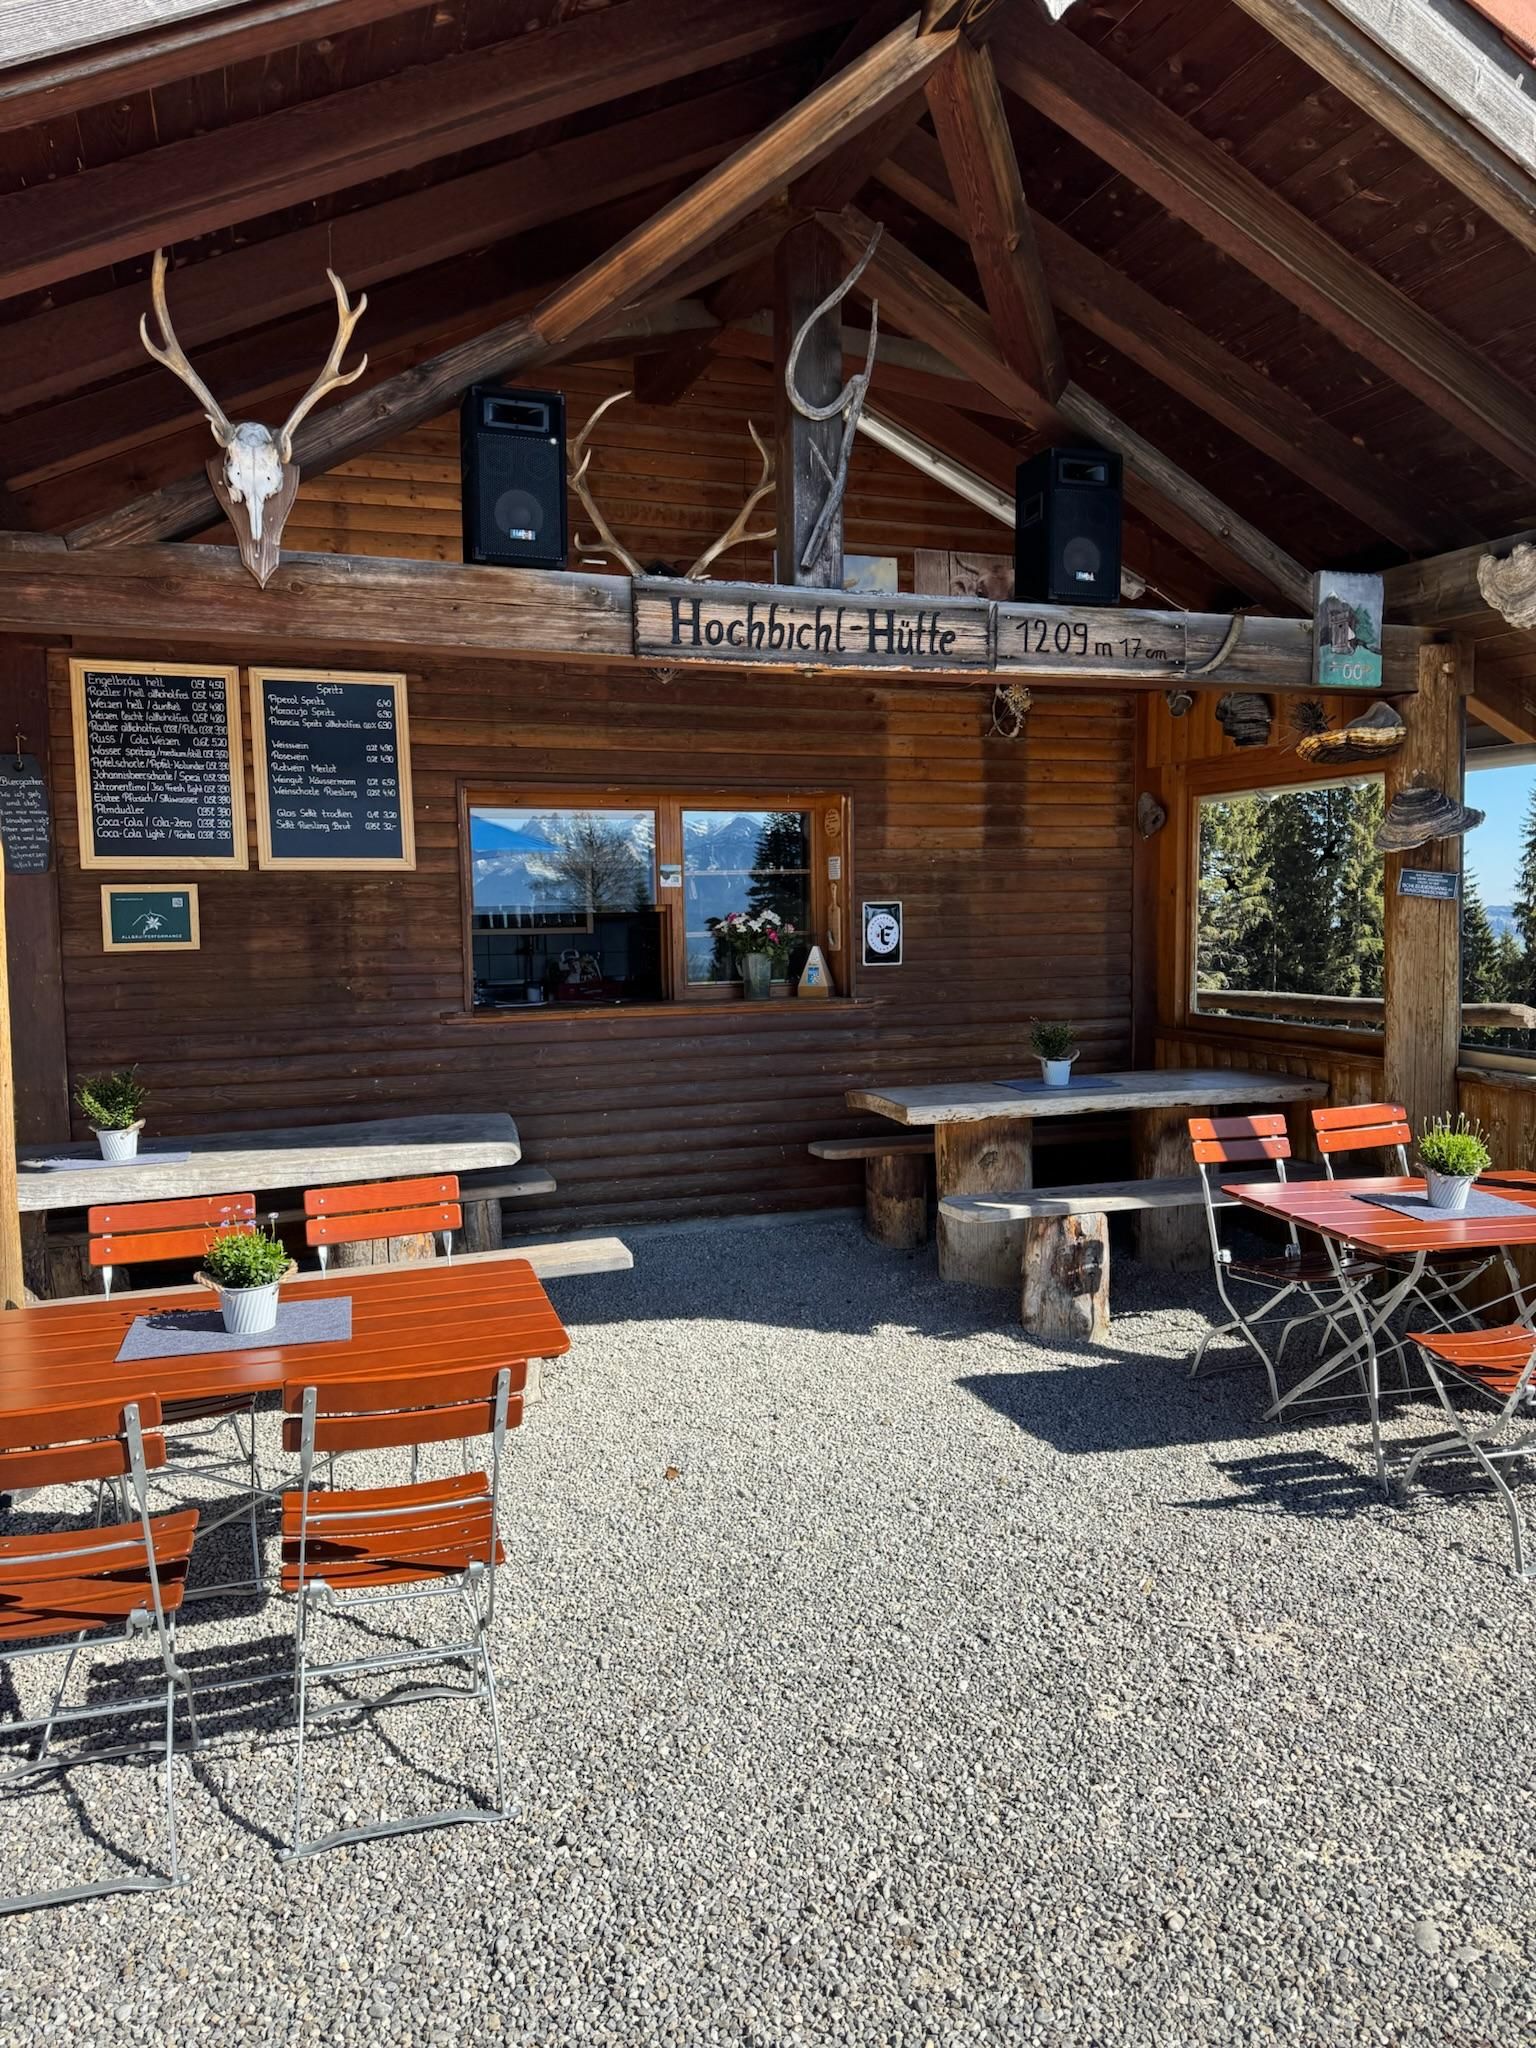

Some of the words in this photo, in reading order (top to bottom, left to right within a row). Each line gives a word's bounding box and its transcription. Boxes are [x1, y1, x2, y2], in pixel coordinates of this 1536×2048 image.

[669, 597, 957, 656] Hochbichl-Hütte
[1016, 619, 1088, 655] 1209
[1095, 642, 1112, 658] m
[1119, 638, 1142, 658] 17
[1145, 648, 1168, 660] cm
[145, 677, 165, 687] hell
[87, 686, 120, 697] Radler
[129, 688, 145, 698] hell
[148, 689, 190, 700] alkoholfrei
[316, 684, 344, 696] Spritz
[89, 698, 122, 709] Weizen
[126, 699, 144, 710] hell
[152, 701, 181, 711] dunkel
[268, 694, 299, 705] Aperol
[301, 696, 326, 706] Spritz
[89, 710, 118, 720] Weizen
[121, 711, 143, 721] leicht
[270, 705, 308, 717] Maracuja
[311, 707, 336, 718] Spritz
[89, 720, 118, 731] Radler
[121, 722, 162, 733] alkoholfrei
[269, 716, 300, 727] Arancia
[302, 718, 323, 728] Spritz
[325, 719, 361, 729] alkoholfrei
[89, 732, 116, 744] Russ
[130, 734, 149, 745] Cola
[150, 735, 180, 746] Weizen
[91, 745, 121, 756] Wasser
[271, 762, 305, 772] Rotwein
[311, 763, 337, 773] Merlot
[272, 774, 303, 786] Weingut
[273, 786, 320, 796] Weinschorle
[324, 786, 357, 799] Riesling
[94, 803, 144, 815] Almdudler
[276, 808, 297, 817] Glas
[299, 808, 317, 818] Sekt
[321, 808, 353, 819] trocken
[96, 815, 144, 827] Coca-Cola
[276, 819, 296, 829] Sekt
[297, 820, 330, 833] Riesling
[331, 821, 352, 830] Brut
[97, 827, 143, 838] Coca-Cola
[174, 829, 195, 839] Fanta
